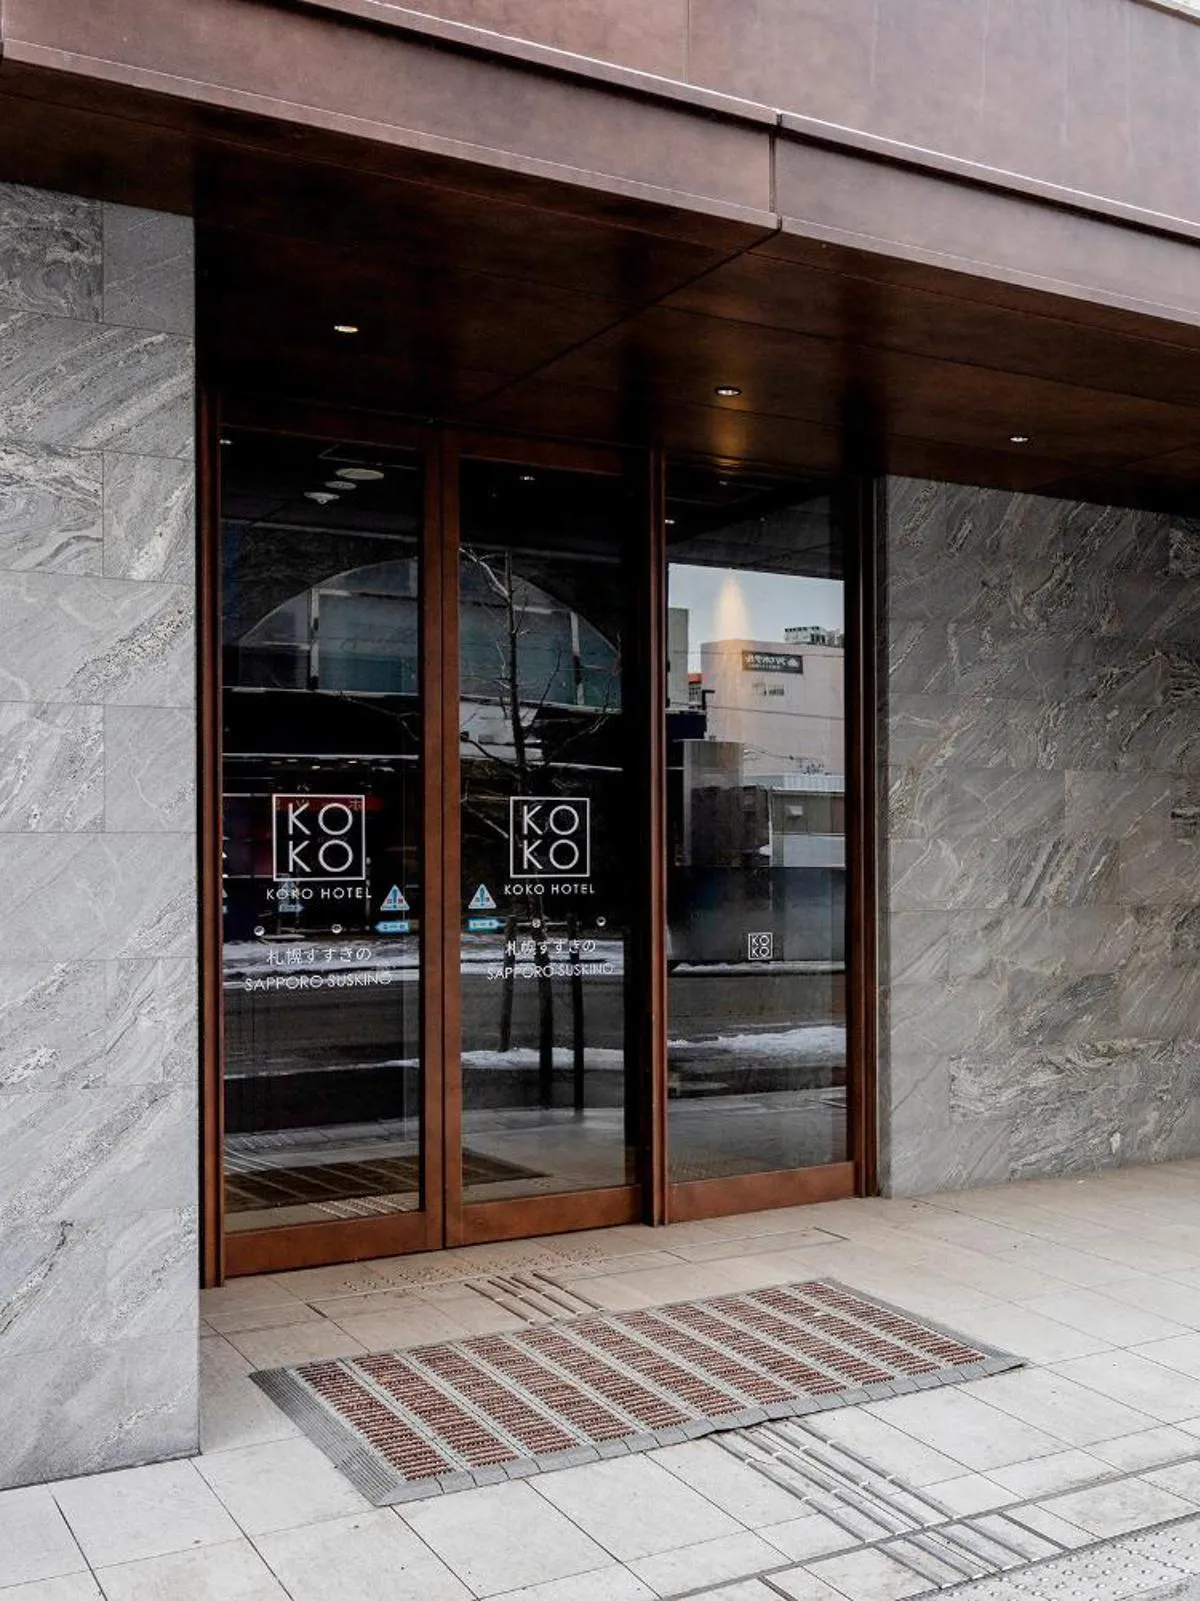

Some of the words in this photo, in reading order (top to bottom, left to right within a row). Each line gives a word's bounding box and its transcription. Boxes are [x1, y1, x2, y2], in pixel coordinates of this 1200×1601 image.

[266, 888, 313, 901] KOKO
[320, 887, 372, 900] HOTEL
[504, 883, 545, 895] KOKO
[551, 883, 596, 895] HOTEL
[266, 947, 372, 965] 札幌すすきの
[505, 940, 597, 956] 札幌すすきの
[487, 964, 554, 980] SAPPORO
[244, 974, 324, 991] SAPPORO
